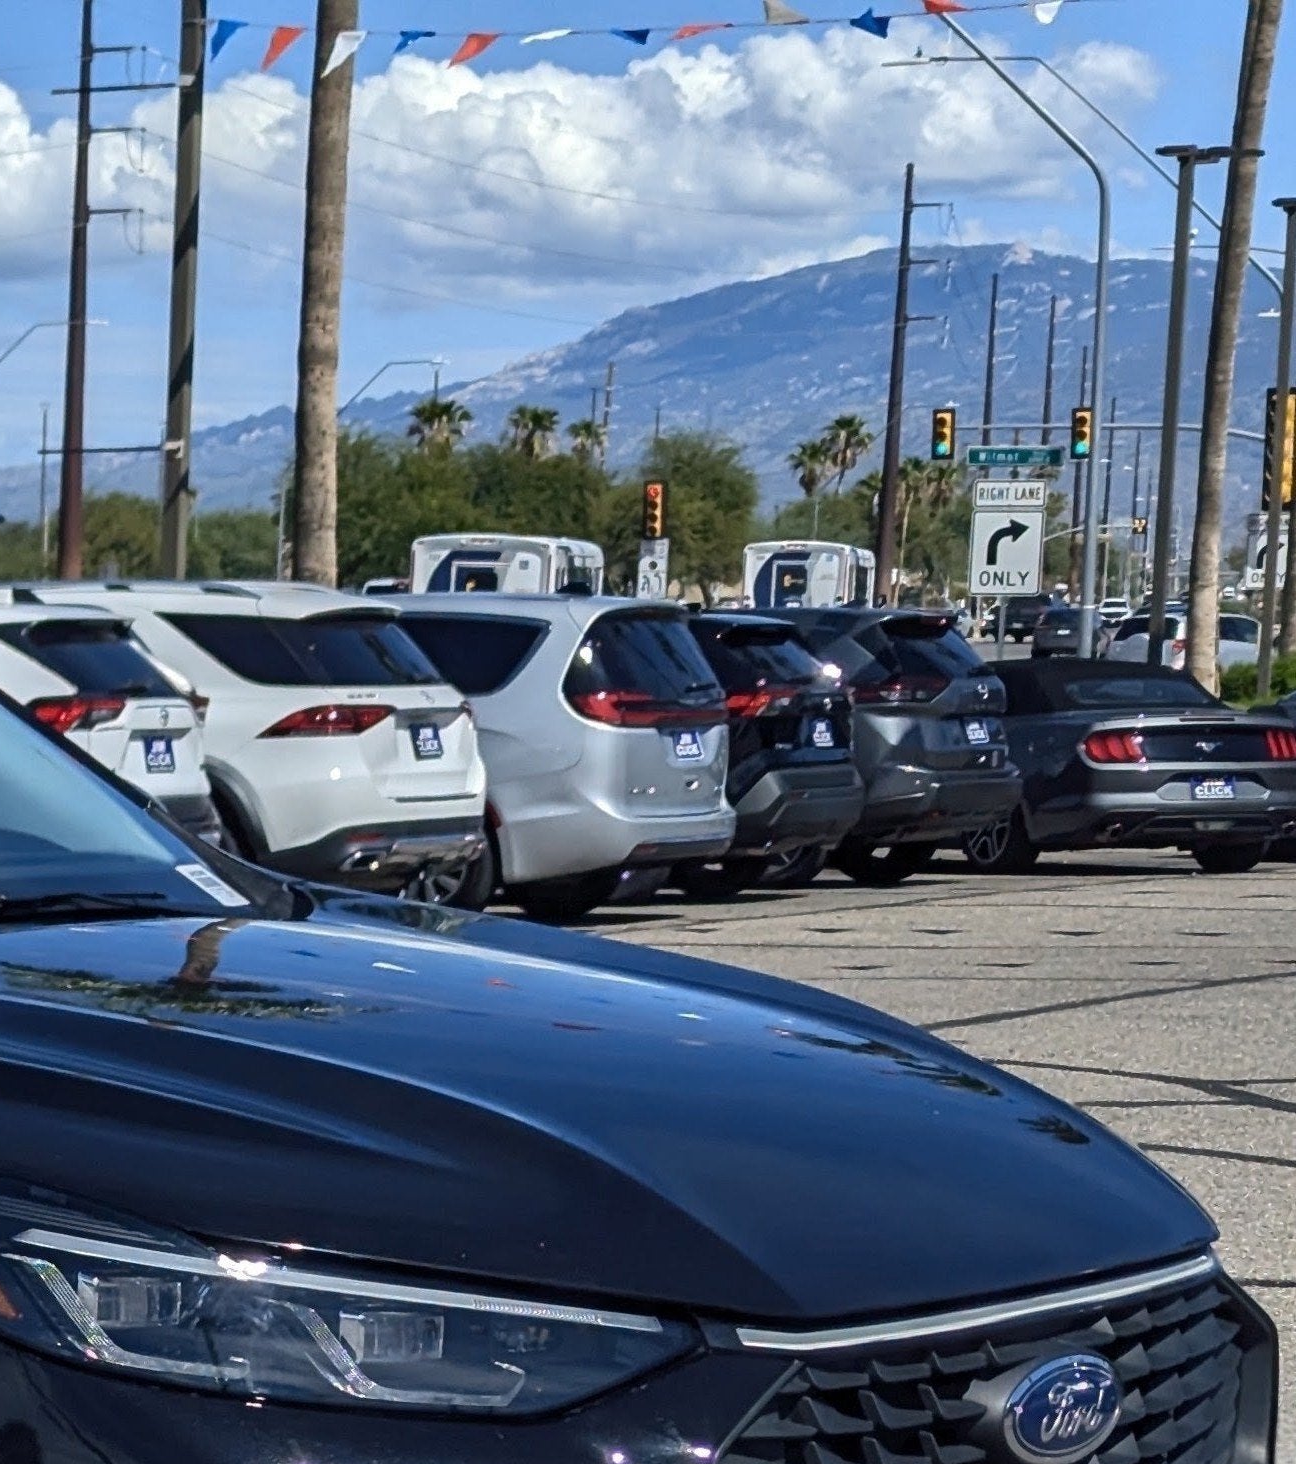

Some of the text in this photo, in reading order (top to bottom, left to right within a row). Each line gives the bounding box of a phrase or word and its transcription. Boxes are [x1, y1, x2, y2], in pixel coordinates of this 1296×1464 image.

[979, 487, 1041, 501] RIGHT LANE
[979, 570, 1029, 587] ONLY
[1039, 1379, 1106, 1443] Ford
